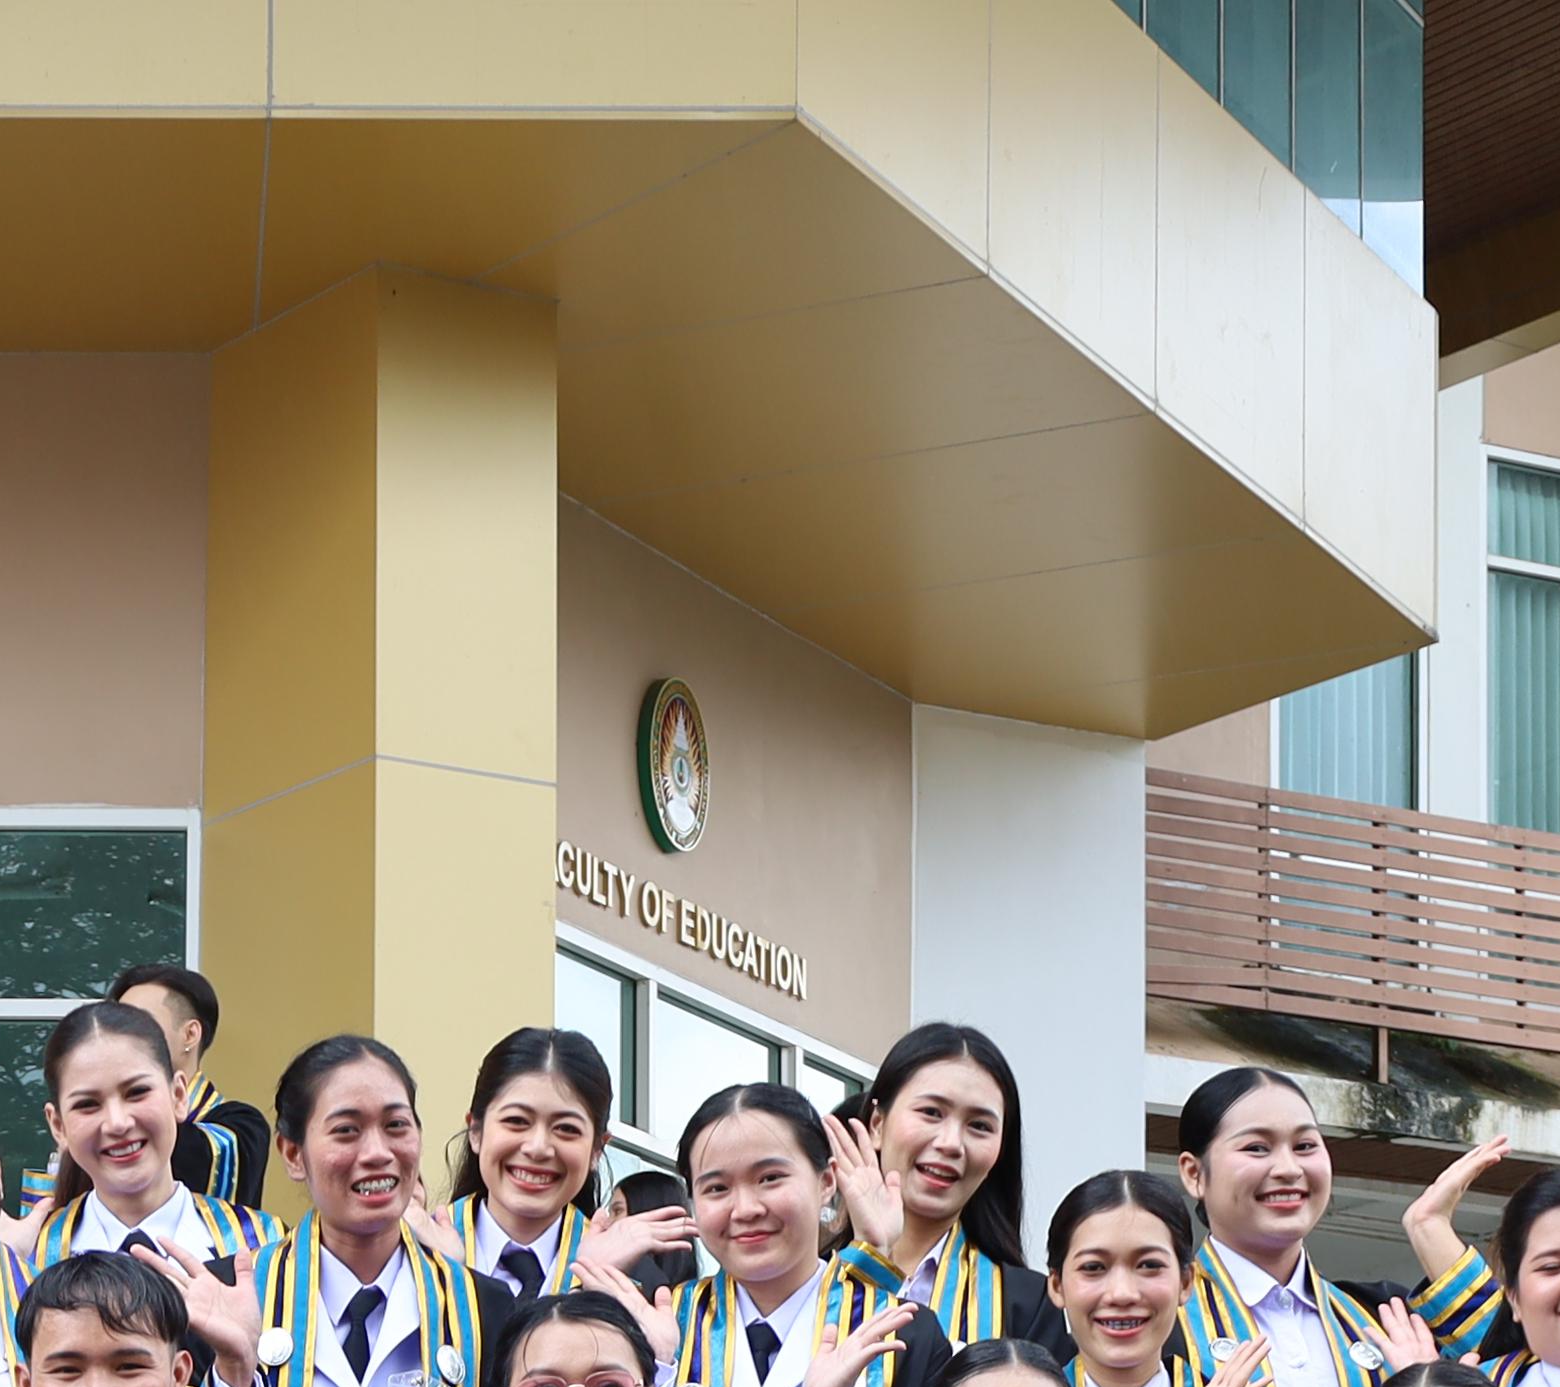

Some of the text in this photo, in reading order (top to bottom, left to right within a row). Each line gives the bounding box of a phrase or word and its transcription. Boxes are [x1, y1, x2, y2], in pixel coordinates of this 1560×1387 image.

[555, 840, 808, 1001] CULTY OF EDUCATION
